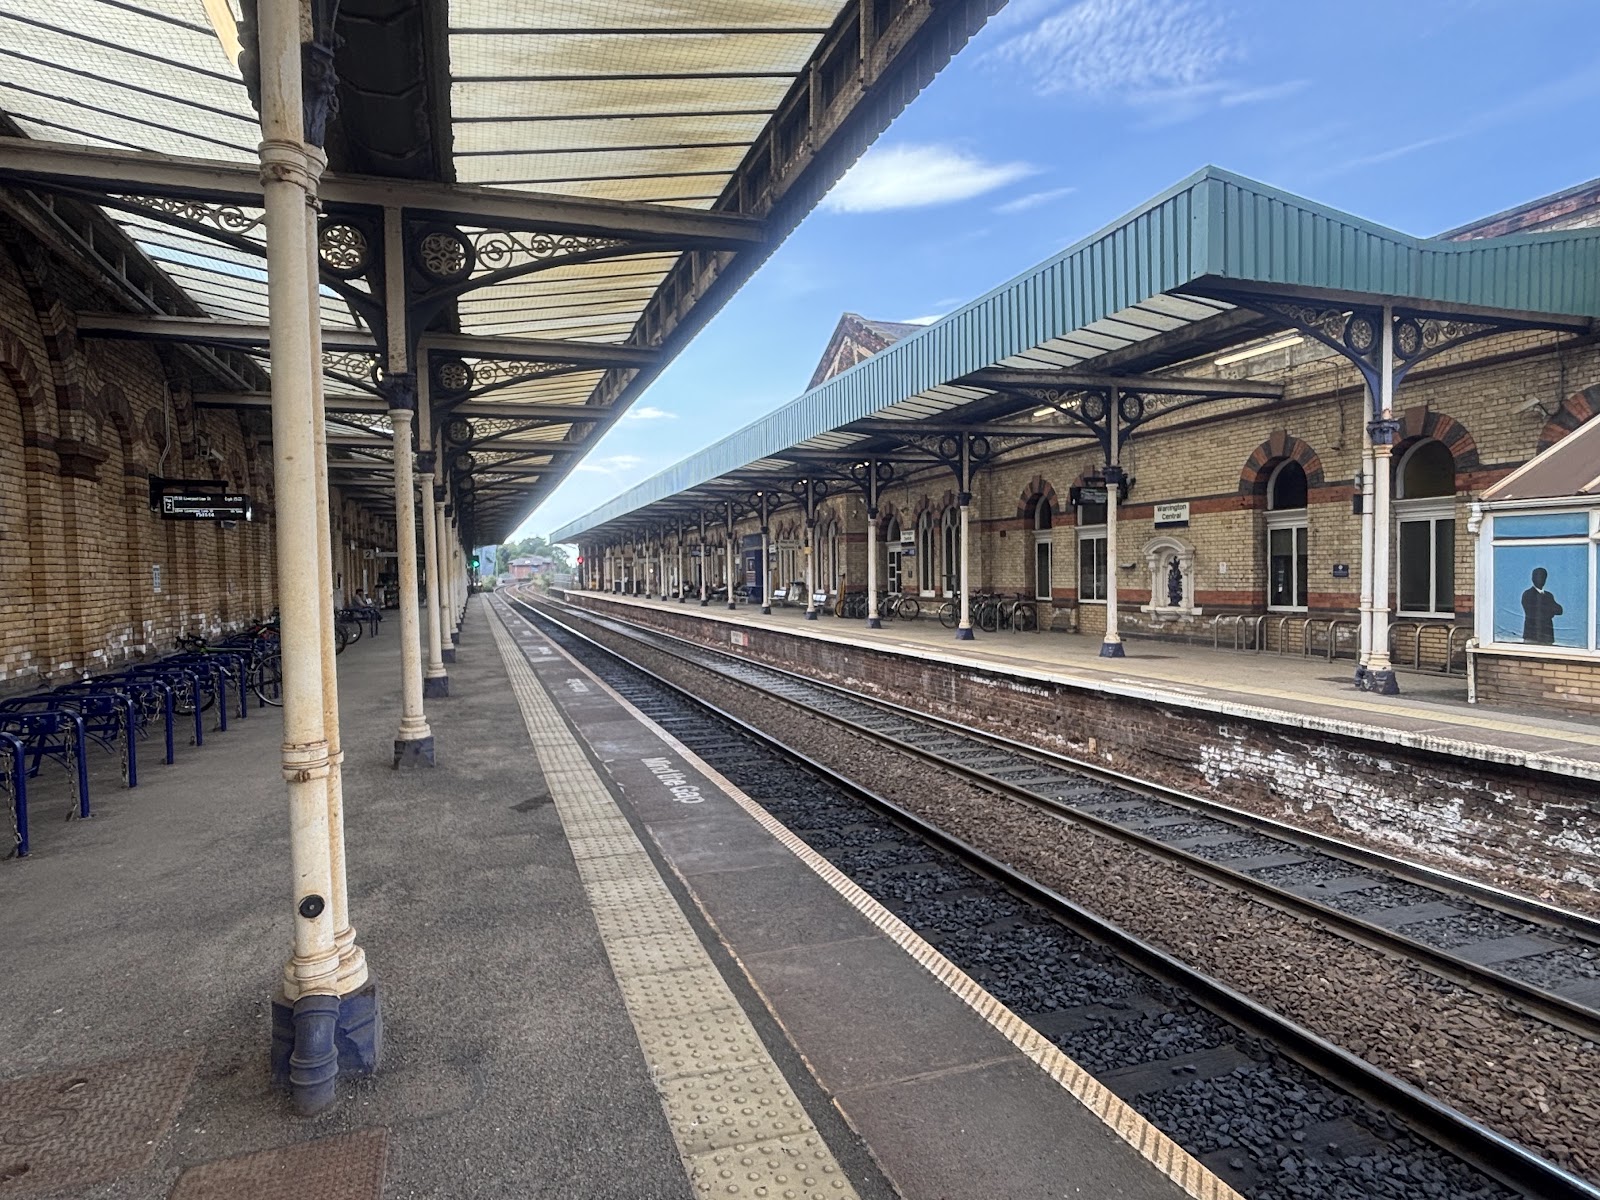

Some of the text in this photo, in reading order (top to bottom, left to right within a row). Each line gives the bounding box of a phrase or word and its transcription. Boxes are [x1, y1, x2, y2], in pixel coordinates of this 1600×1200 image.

[1157, 504, 1187, 512] Warrington
[1162, 512, 1182, 520] Central
[640, 757, 706, 804] Mind the Gap
